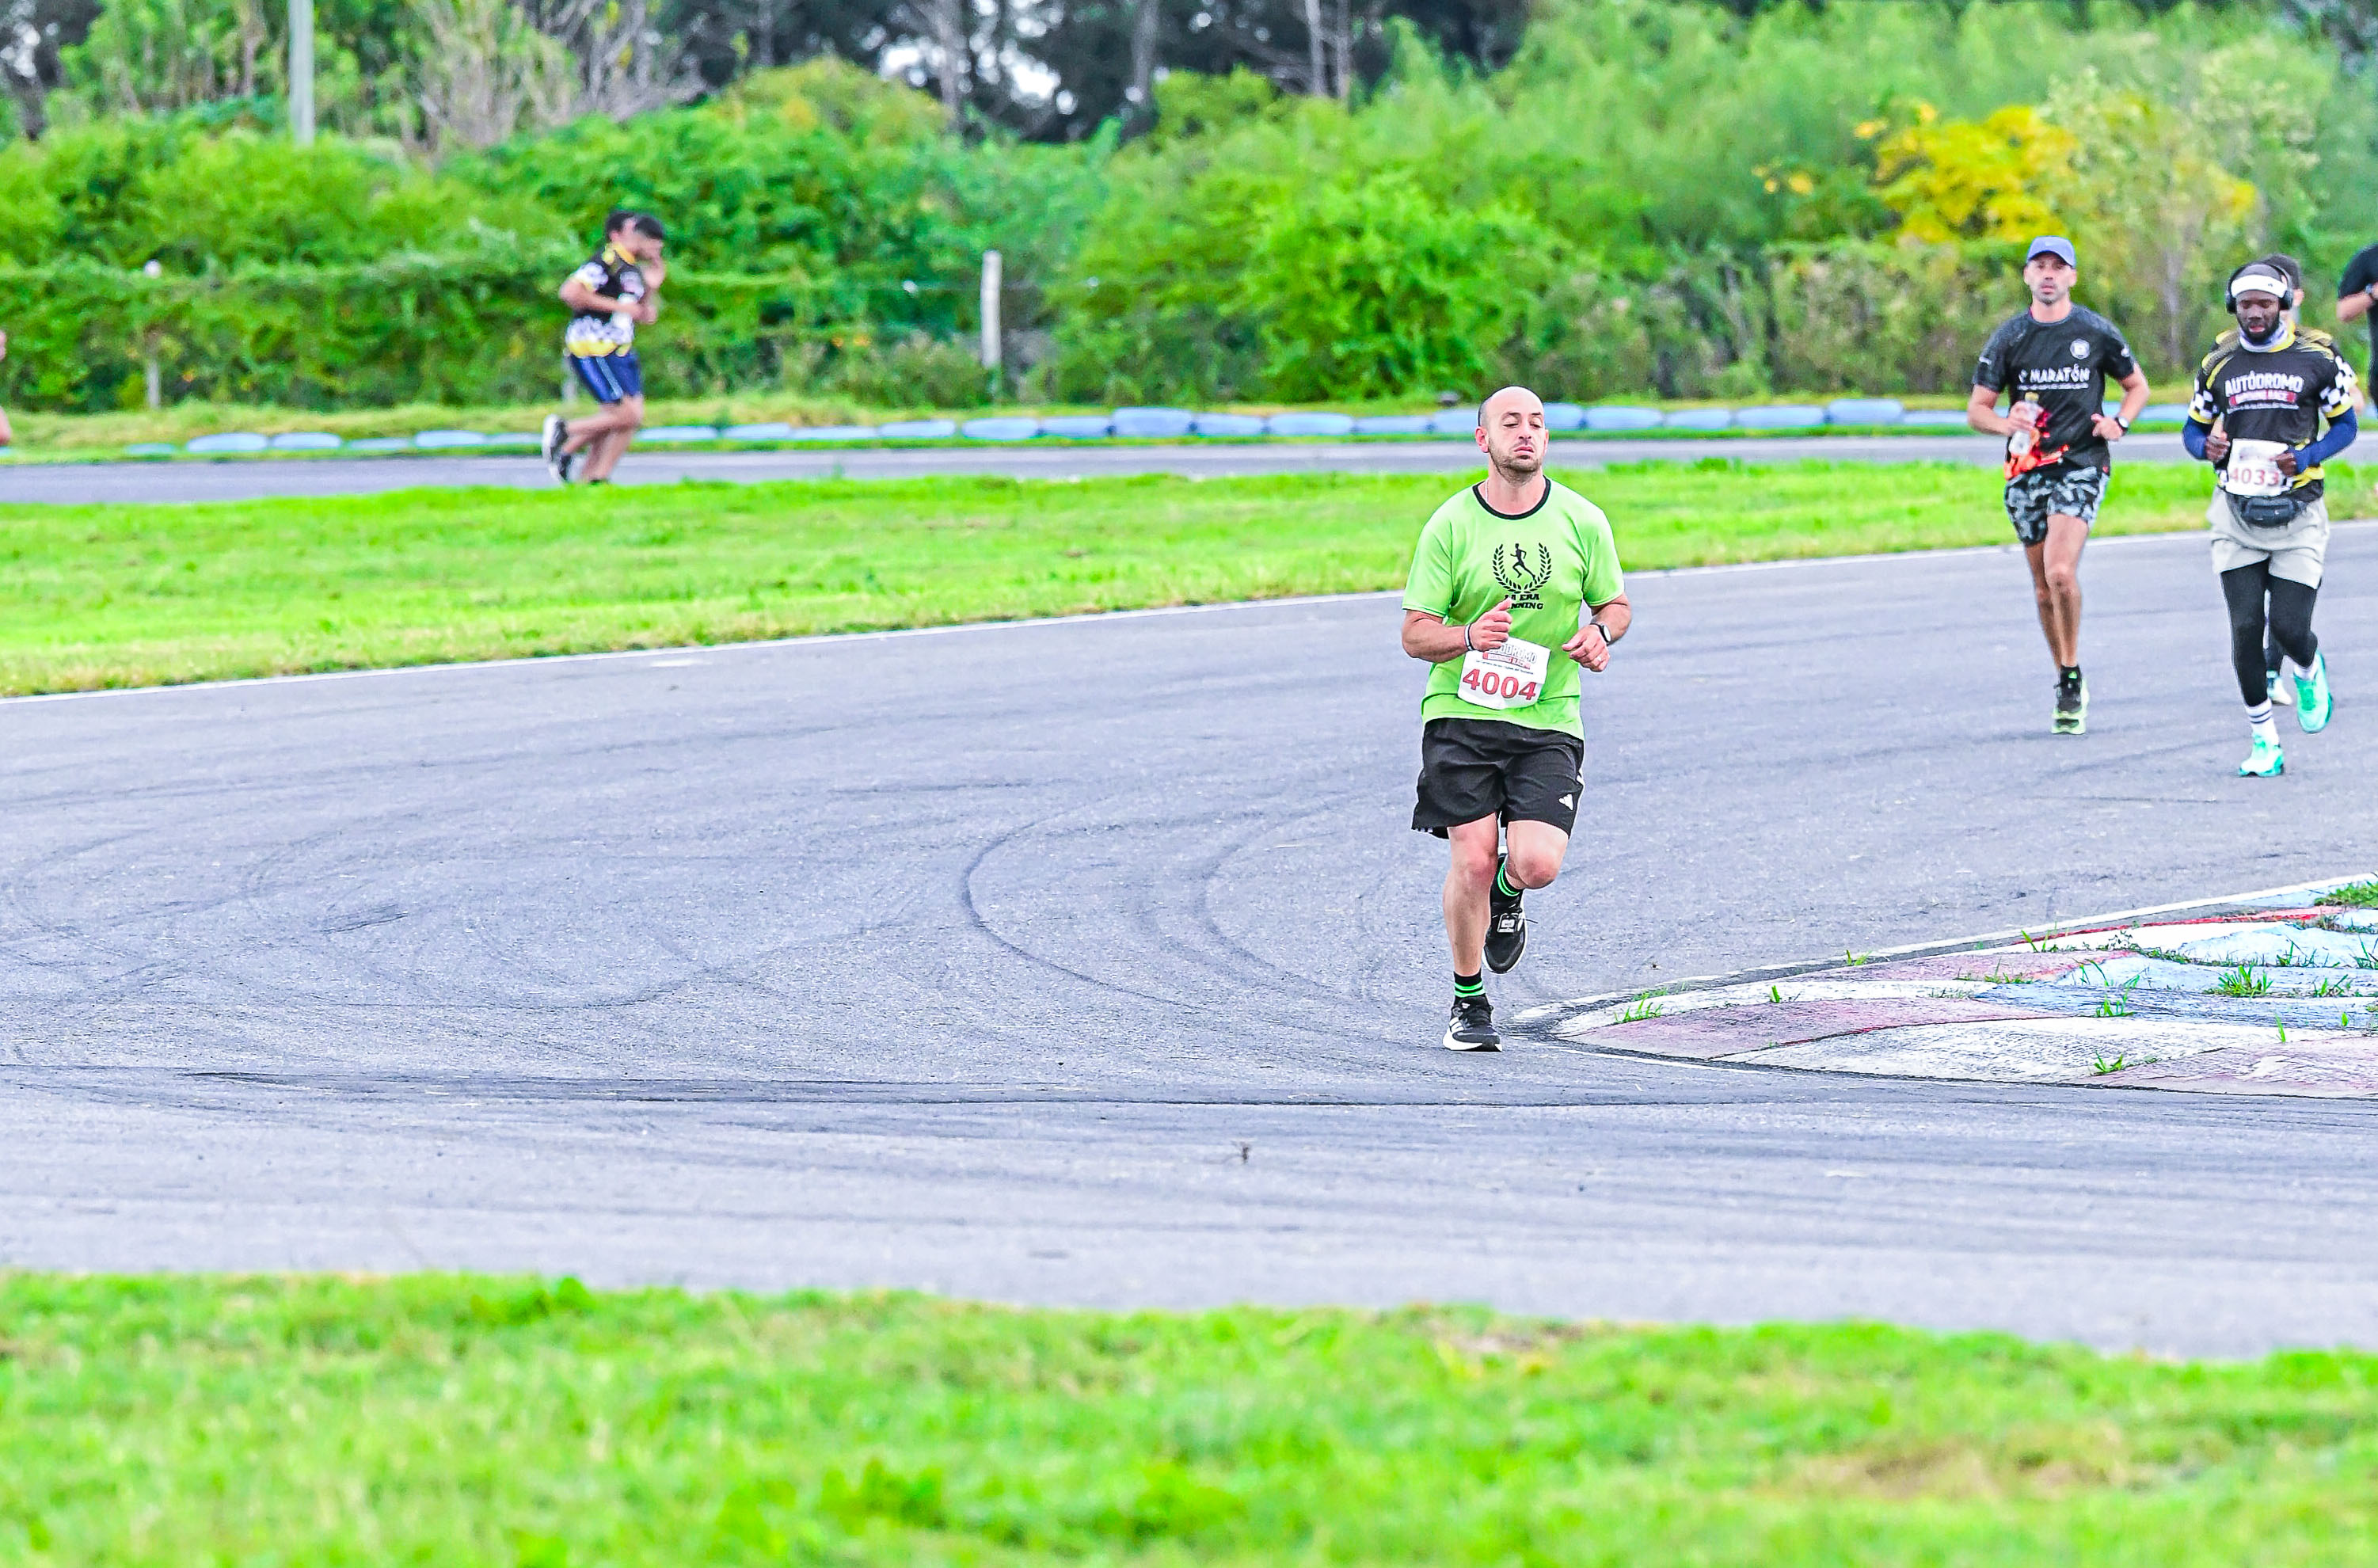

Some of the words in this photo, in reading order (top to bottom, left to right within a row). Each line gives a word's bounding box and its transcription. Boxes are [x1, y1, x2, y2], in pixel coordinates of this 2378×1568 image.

[2030, 363, 2091, 383] MARATÓN
[2224, 370, 2304, 398] AUTÓDROMO
[2229, 467, 2279, 487] 4033
[1463, 668, 1537, 701] 4004
